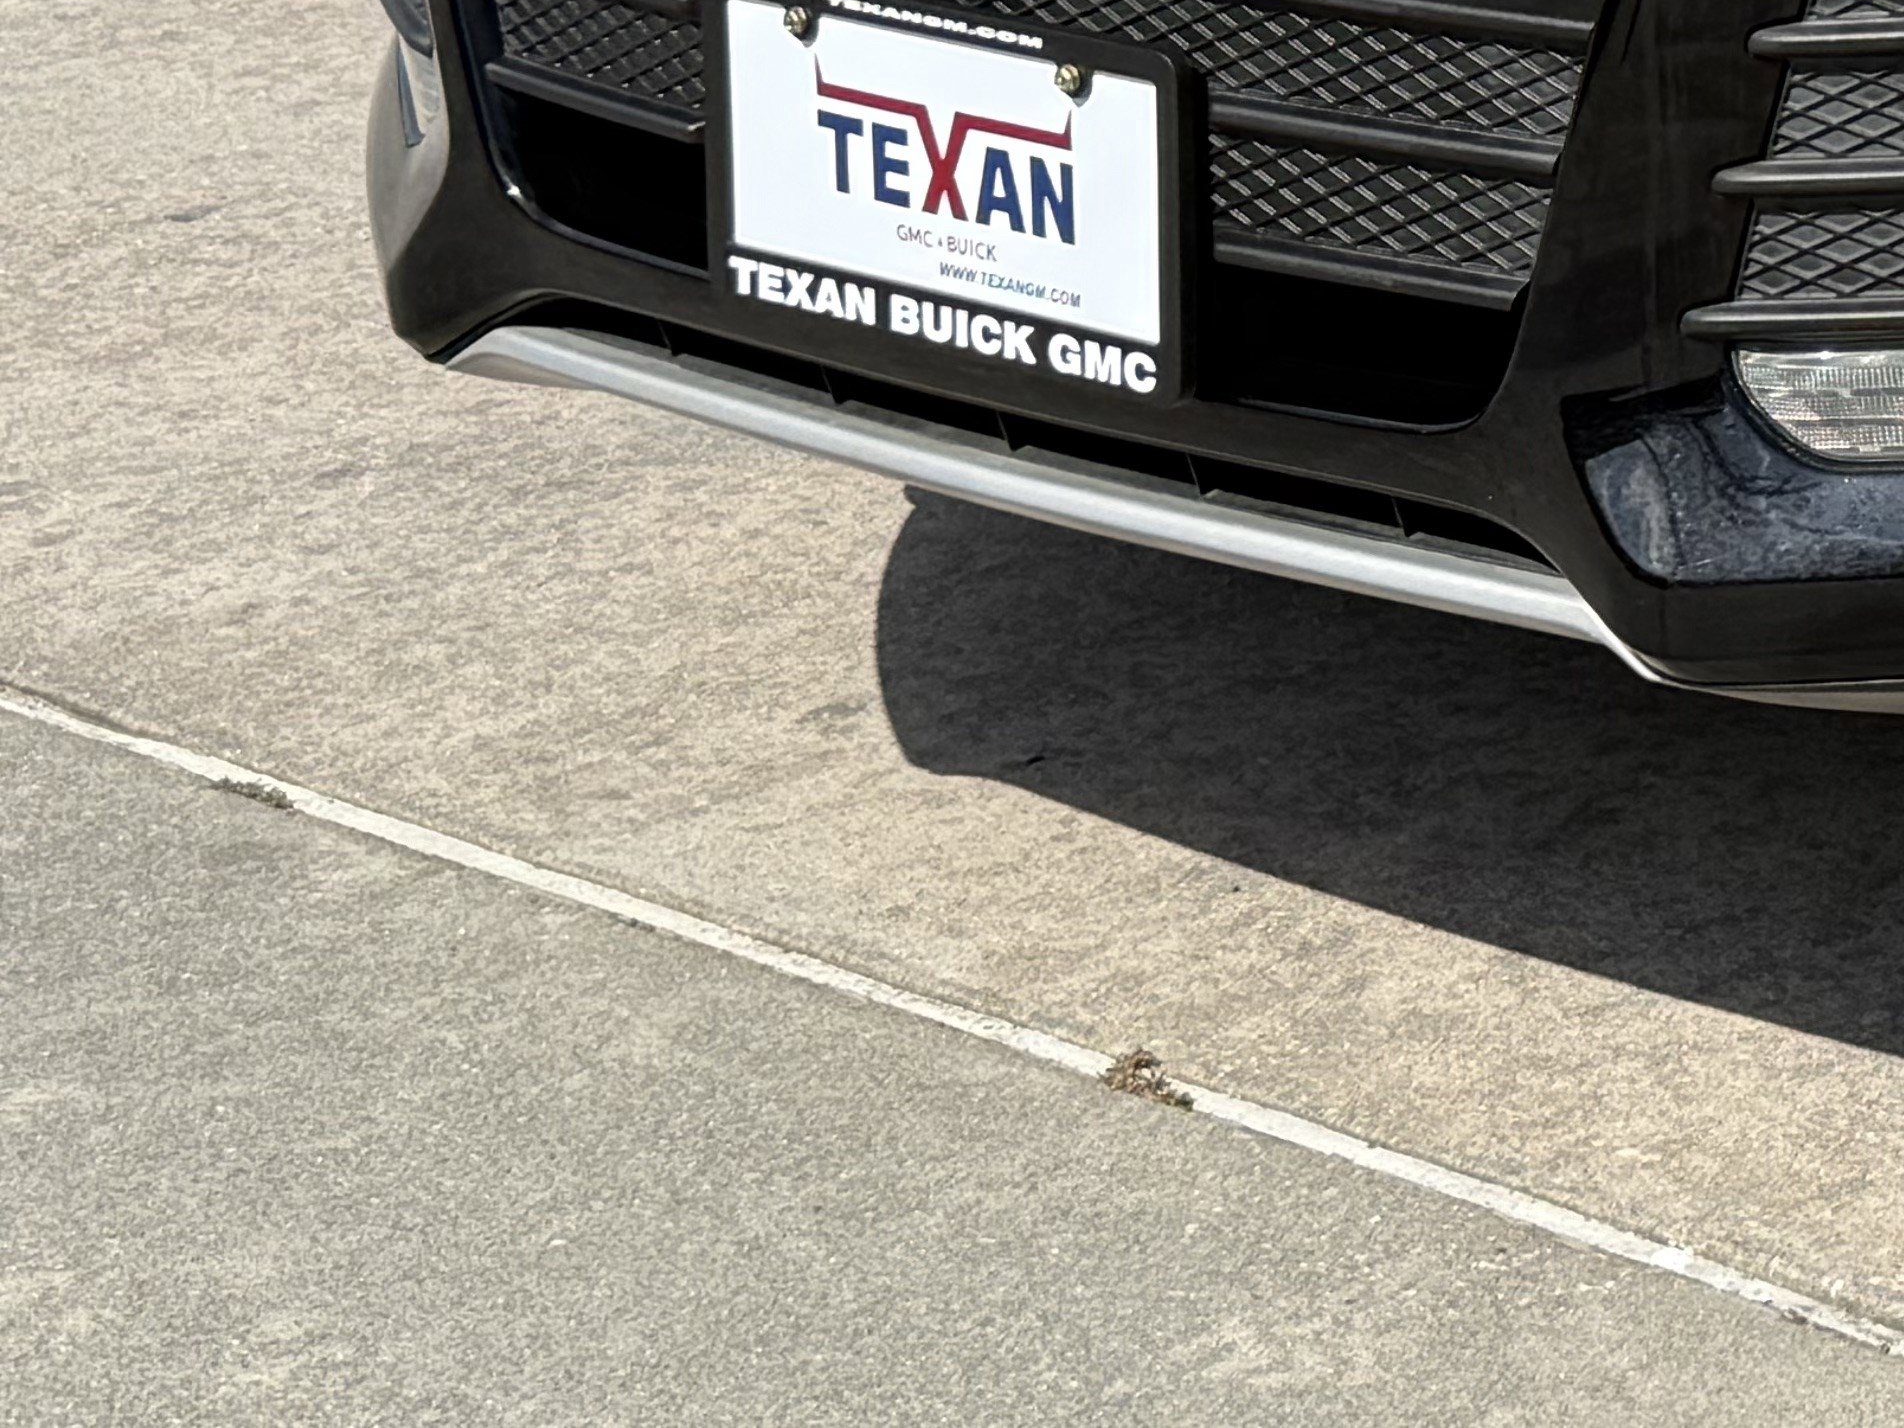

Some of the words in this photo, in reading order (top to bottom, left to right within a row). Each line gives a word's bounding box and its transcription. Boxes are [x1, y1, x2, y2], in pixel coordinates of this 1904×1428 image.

[815, 56, 1076, 245] TEXAN
[896, 224, 933, 249] GMC
[947, 235, 998, 262] BUICK
[728, 255, 876, 325] TEXAN
[889, 293, 1037, 365] BUICK
[1048, 333, 1157, 394] GMC
